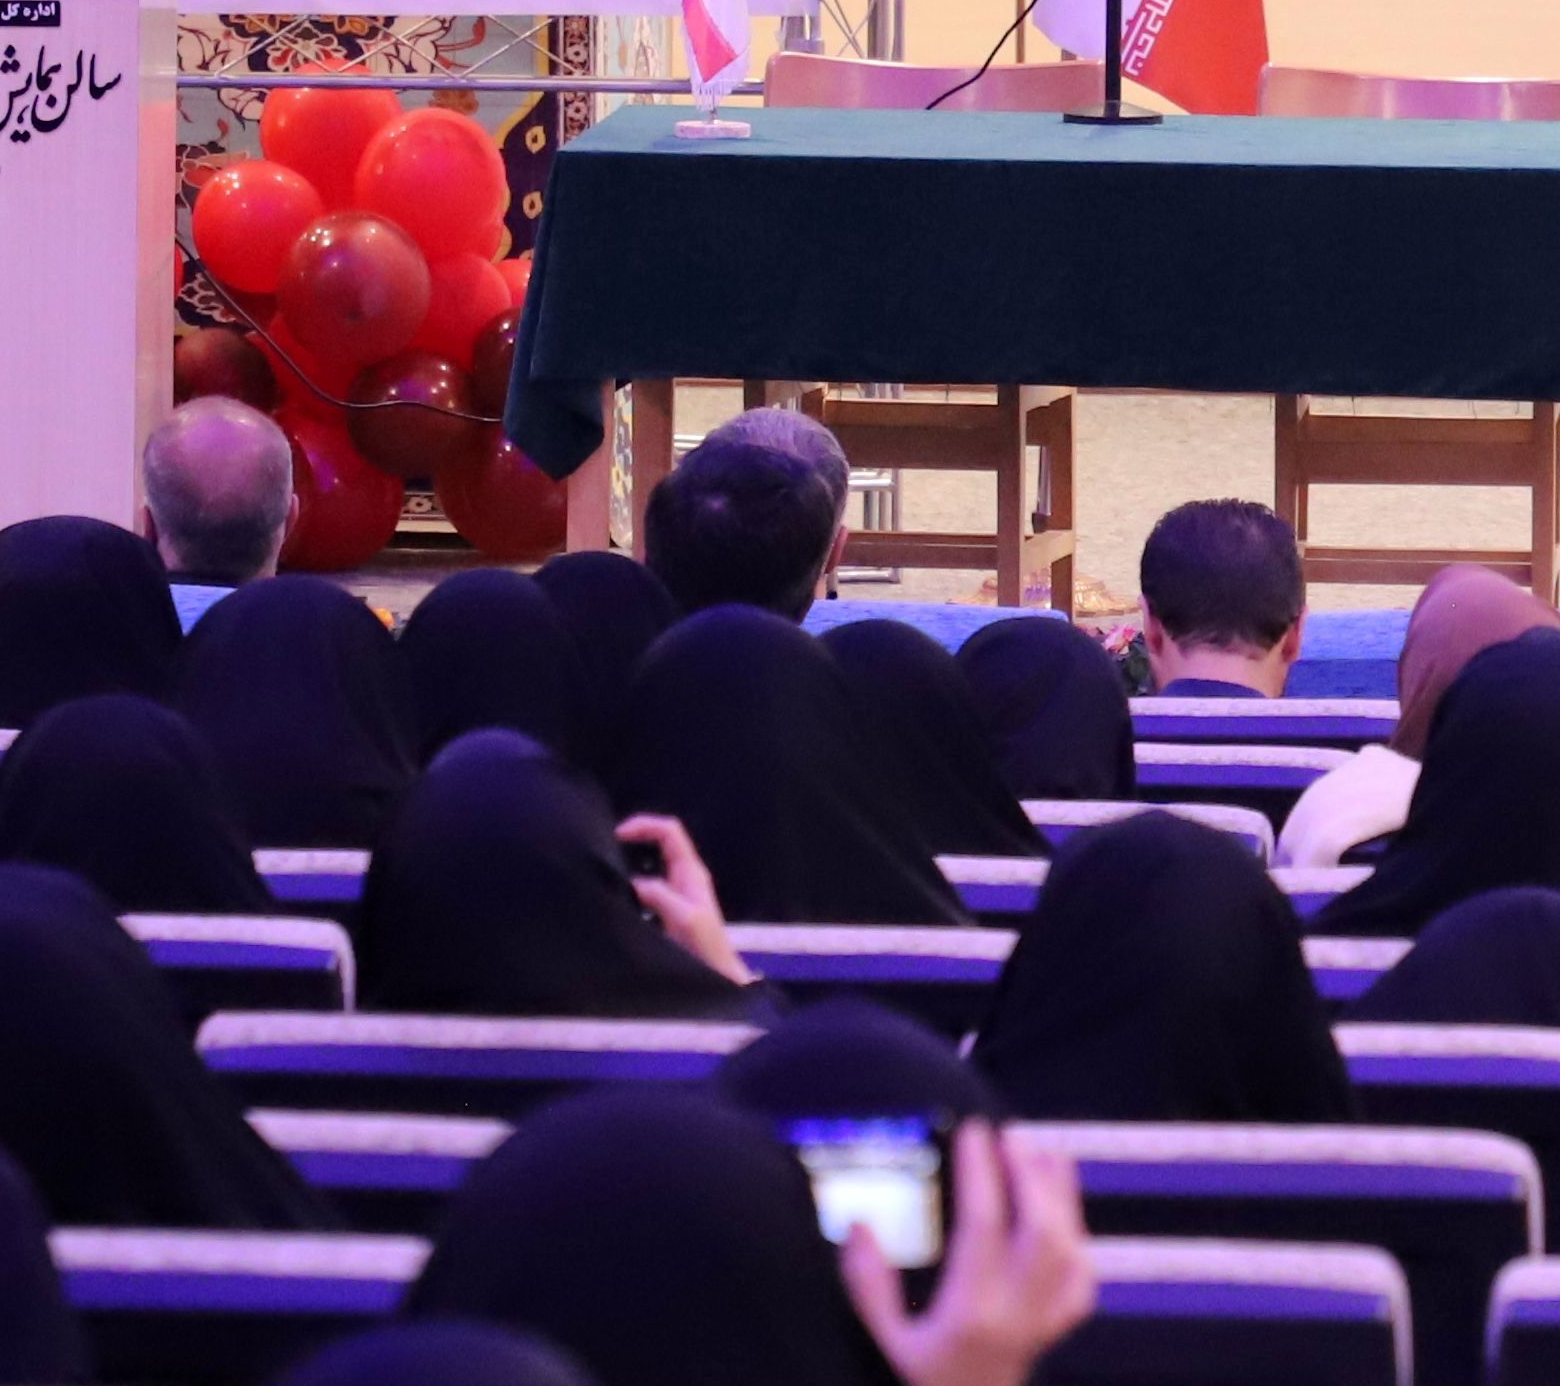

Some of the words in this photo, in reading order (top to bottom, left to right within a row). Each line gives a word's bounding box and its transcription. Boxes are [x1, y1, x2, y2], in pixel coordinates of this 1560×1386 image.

[0, 3, 20, 20] کل
[23, 2, 56, 22] اداره
[31, 45, 122, 133] سالن
